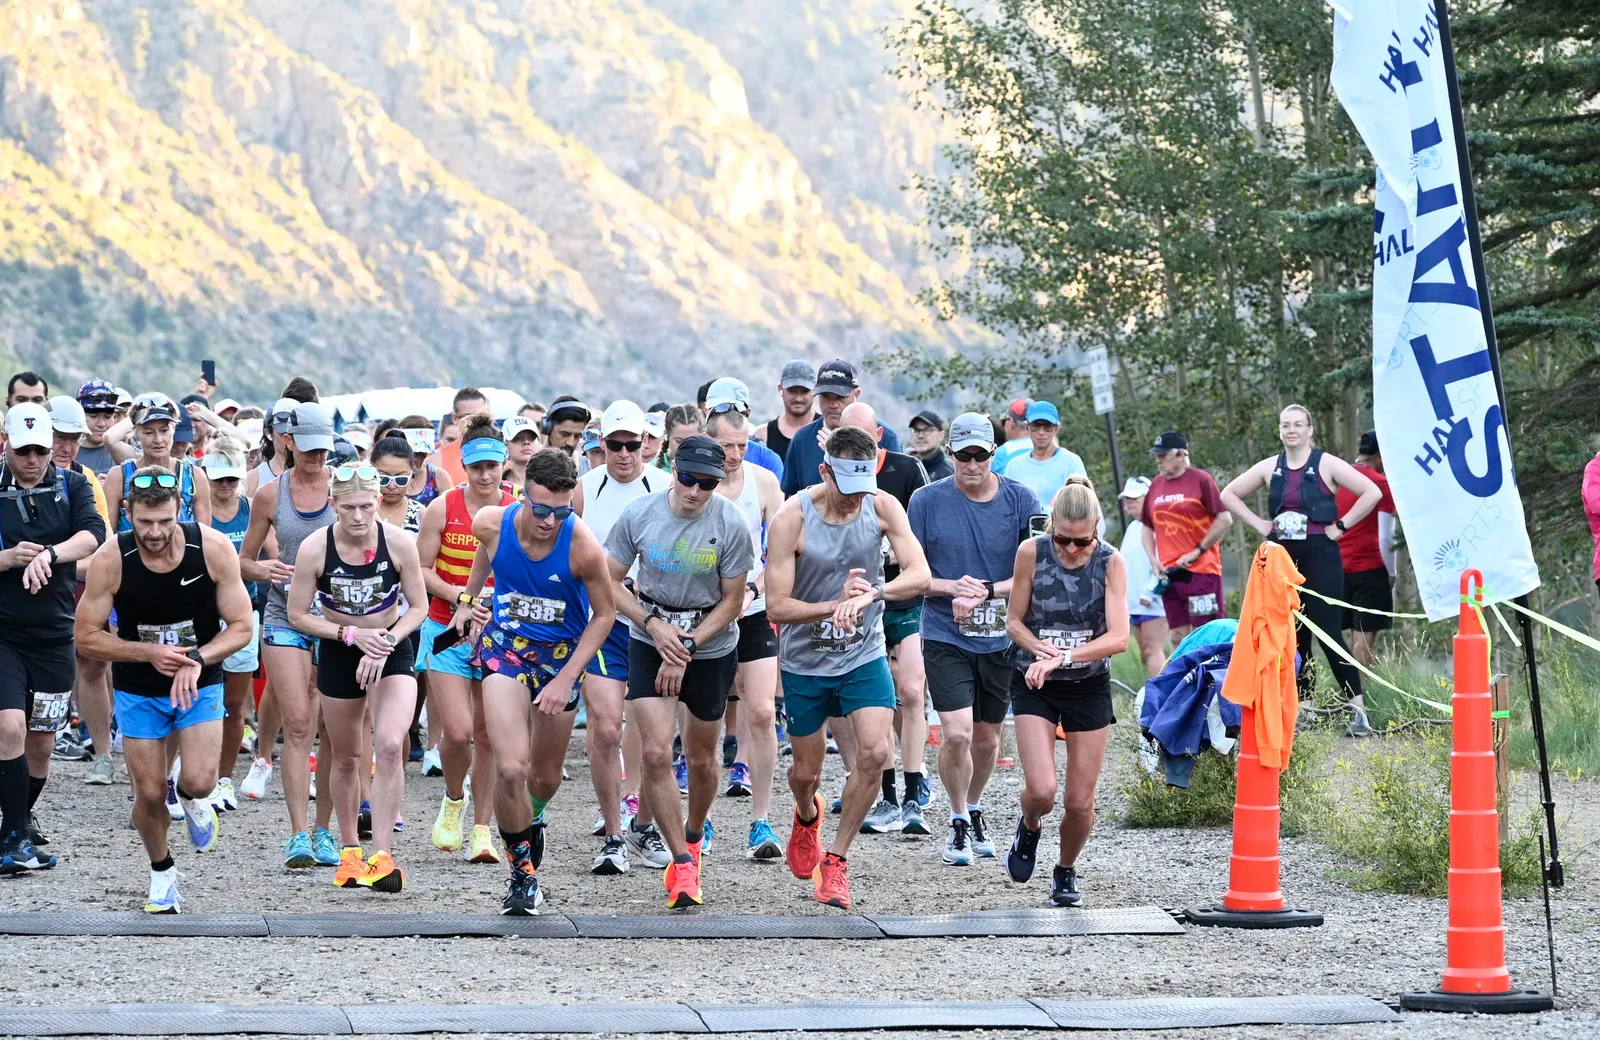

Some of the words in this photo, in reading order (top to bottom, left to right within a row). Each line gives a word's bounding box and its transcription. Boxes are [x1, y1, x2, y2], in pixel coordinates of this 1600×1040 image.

[1374, 228, 1415, 266] HAL
[341, 585, 374, 604] 152
[517, 600, 556, 622] 338
[973, 607, 997, 625] 56
[154, 630, 180, 646] 79
[41, 700, 69, 719] 785
